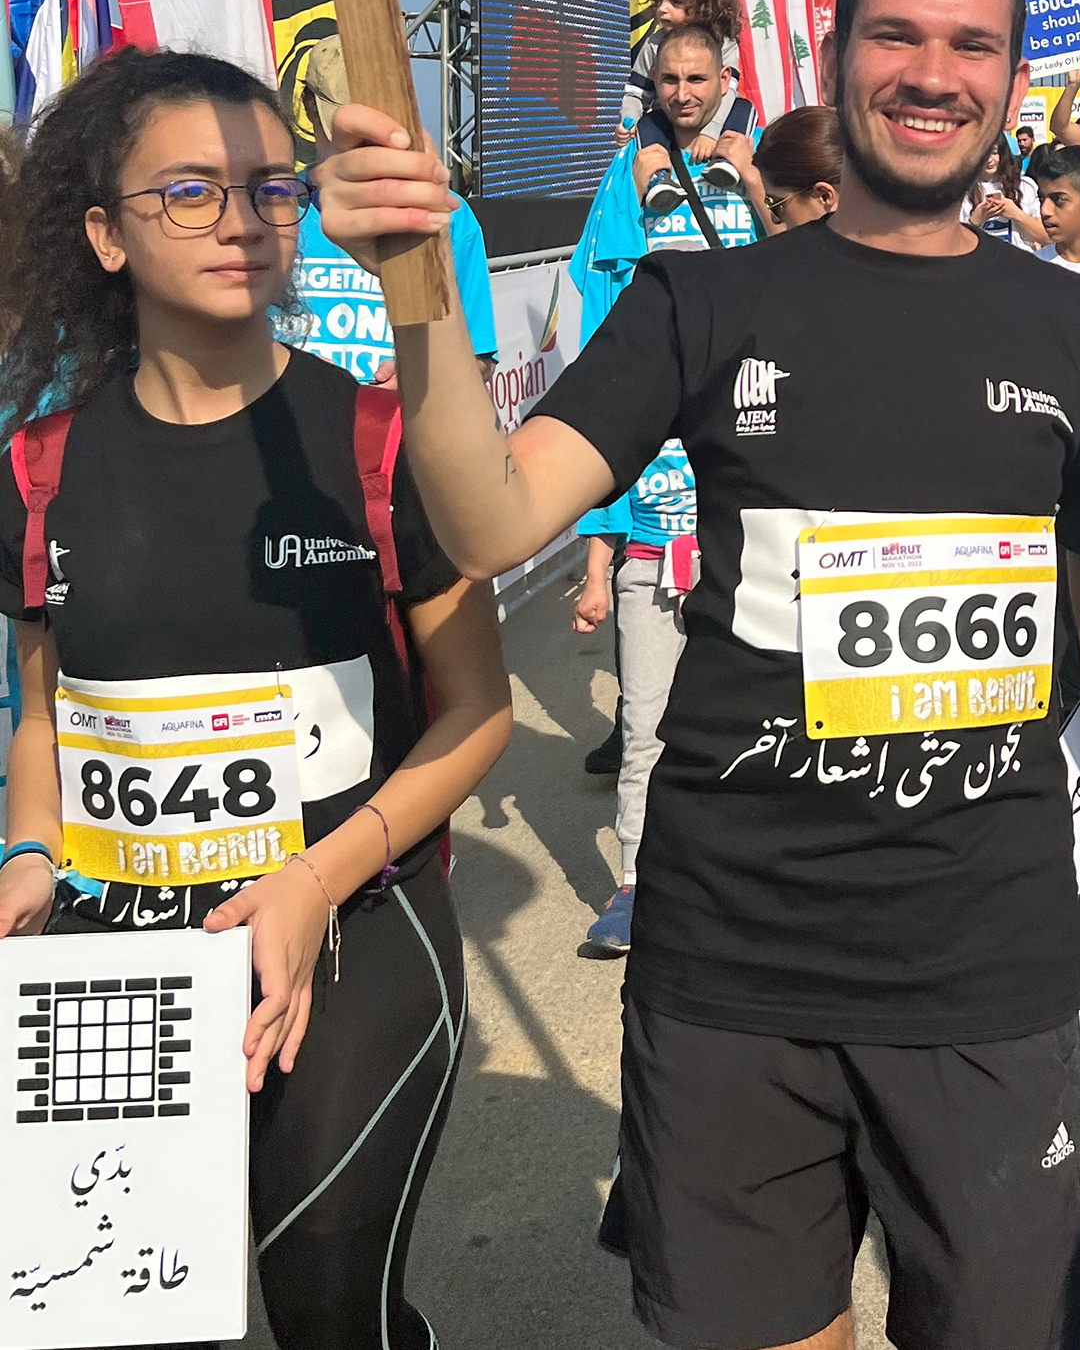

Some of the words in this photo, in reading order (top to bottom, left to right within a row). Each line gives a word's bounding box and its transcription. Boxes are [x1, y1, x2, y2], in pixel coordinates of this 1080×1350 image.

[1030, 36, 1049, 50] be
[1052, 36, 1062, 45] a
[1045, 59, 1063, 70] Lady
[1065, 57, 1075, 65] Of
[645, 215, 687, 235] FOR
[326, 302, 395, 343] ON
[736, 409, 777, 425] AJEM
[637, 469, 688, 498] FOR
[882, 543, 922, 555] BEIRUT
[954, 545, 994, 557] AQUAFINA
[819, 550, 868, 569] OMT
[838, 592, 1038, 668] 8666
[891, 684, 901, 720] i
[70, 712, 98, 730] OMT
[161, 720, 204, 732] AQUAFINA
[213, 717, 228, 728] CFI
[255, 712, 282, 722] mtv
[81, 758, 277, 827] 8648
[117, 839, 126, 871] i
[1041, 1140, 1075, 1168] adidas
[120, 1247, 189, 1297] طاقة
